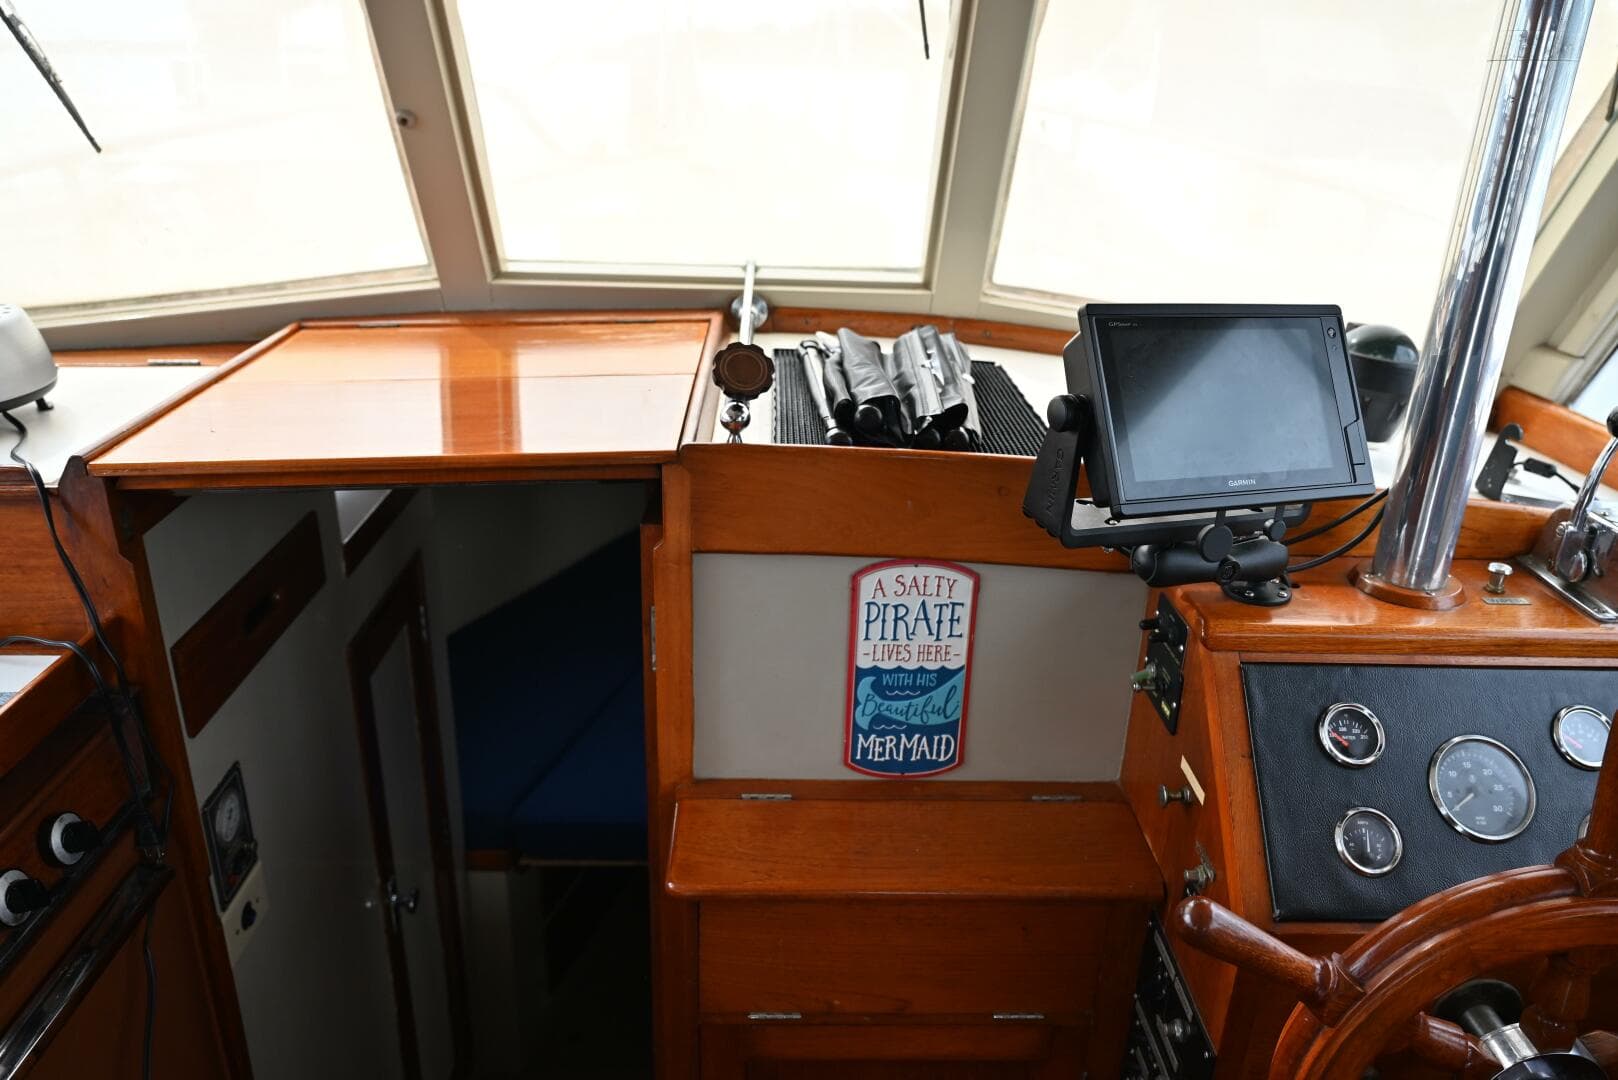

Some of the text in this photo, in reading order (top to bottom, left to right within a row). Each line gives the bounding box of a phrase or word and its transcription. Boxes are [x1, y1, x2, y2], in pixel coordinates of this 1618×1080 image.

[1228, 479, 1256, 487] GARMIN
[872, 574, 957, 599] A SALTY
[863, 599, 964, 641] PIRATE
[882, 673, 937, 687] WITH HIS
[861, 684, 960, 724] Beautiful
[856, 733, 955, 761] MERMAID
[1462, 761, 1472, 769] 15
[1482, 768, 1493, 776] 20
